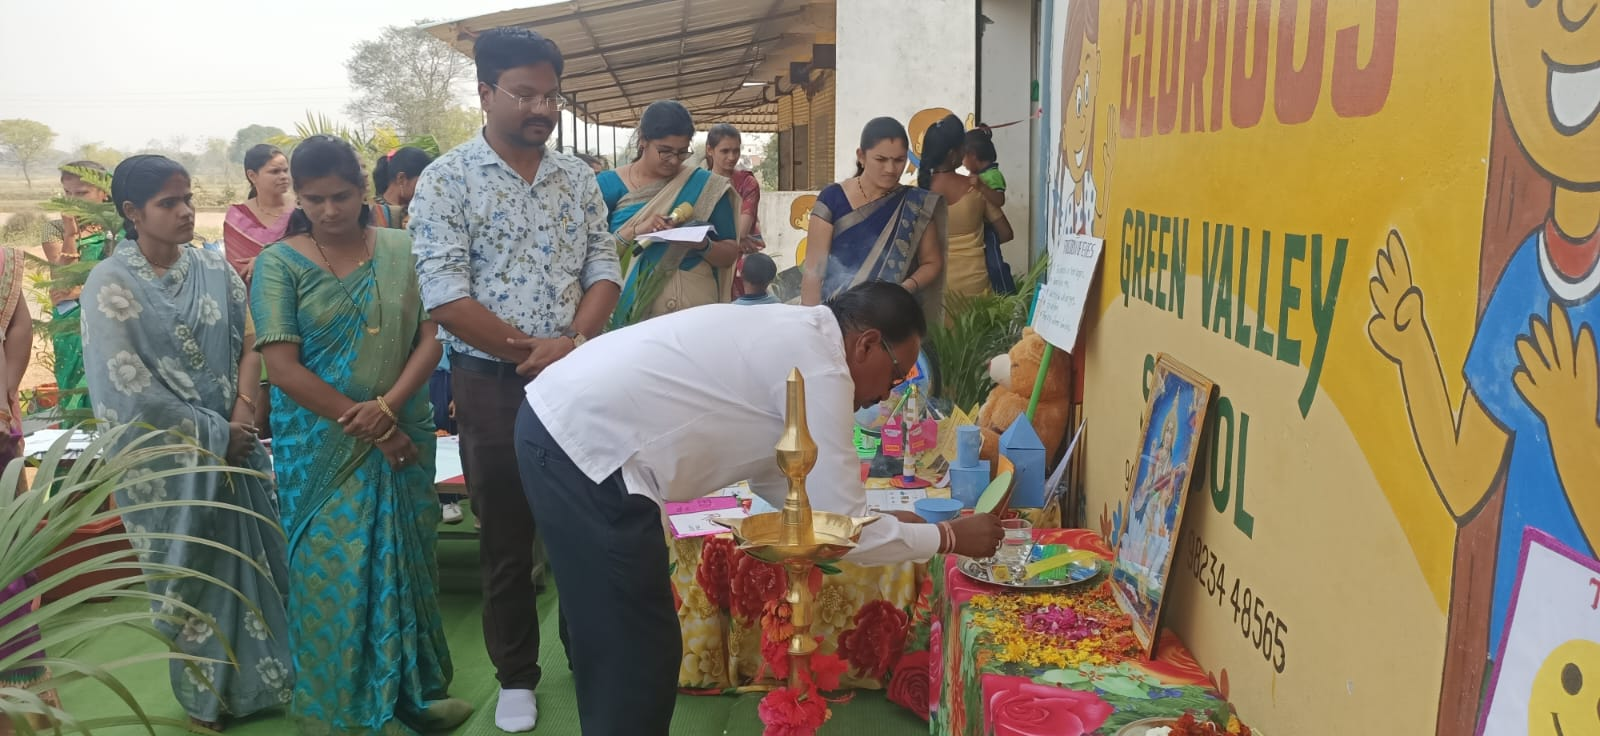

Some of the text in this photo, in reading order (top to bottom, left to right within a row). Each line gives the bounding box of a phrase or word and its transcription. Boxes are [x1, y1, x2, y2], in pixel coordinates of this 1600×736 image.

[1120, 208, 1349, 420] GREEN VALLEY
[1187, 529, 1288, 674] 98234 48565
